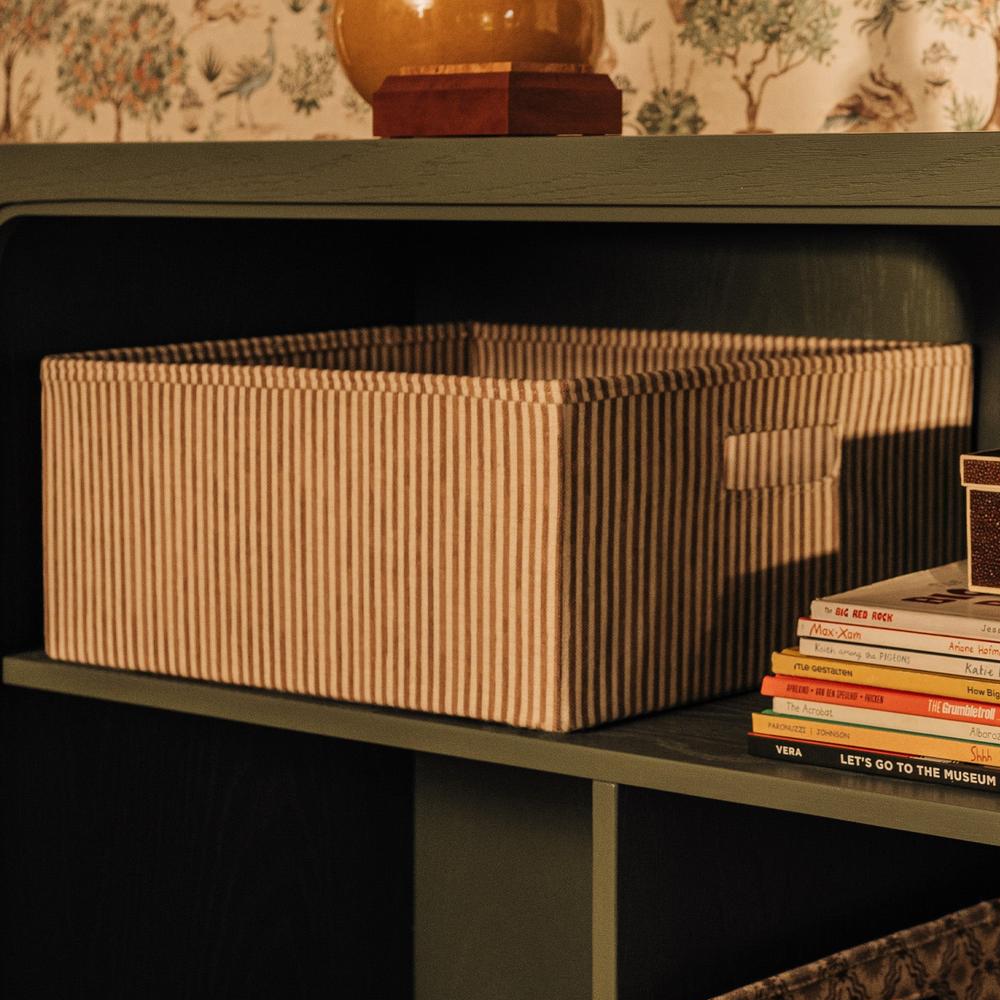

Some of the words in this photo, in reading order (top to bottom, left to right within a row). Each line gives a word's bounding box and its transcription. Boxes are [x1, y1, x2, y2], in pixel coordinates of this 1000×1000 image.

[835, 607, 849, 617] BIG
[852, 609, 868, 620] RED
[872, 611, 894, 622] ROCK
[965, 662, 994, 676] Katie
[967, 686, 986, 696] How
[987, 688, 1000, 699] Big
[928, 698, 942, 714] THE
[942, 702, 996, 720] Grumbletroll
[775, 745, 803, 757] VERA
[970, 745, 993, 761] Shhh
[840, 753, 872, 768] LET'S
[875, 760, 893, 771] GO
[896, 762, 913, 774] TO
[916, 764, 941, 779] THE
[944, 768, 997, 787] MUSEUM
